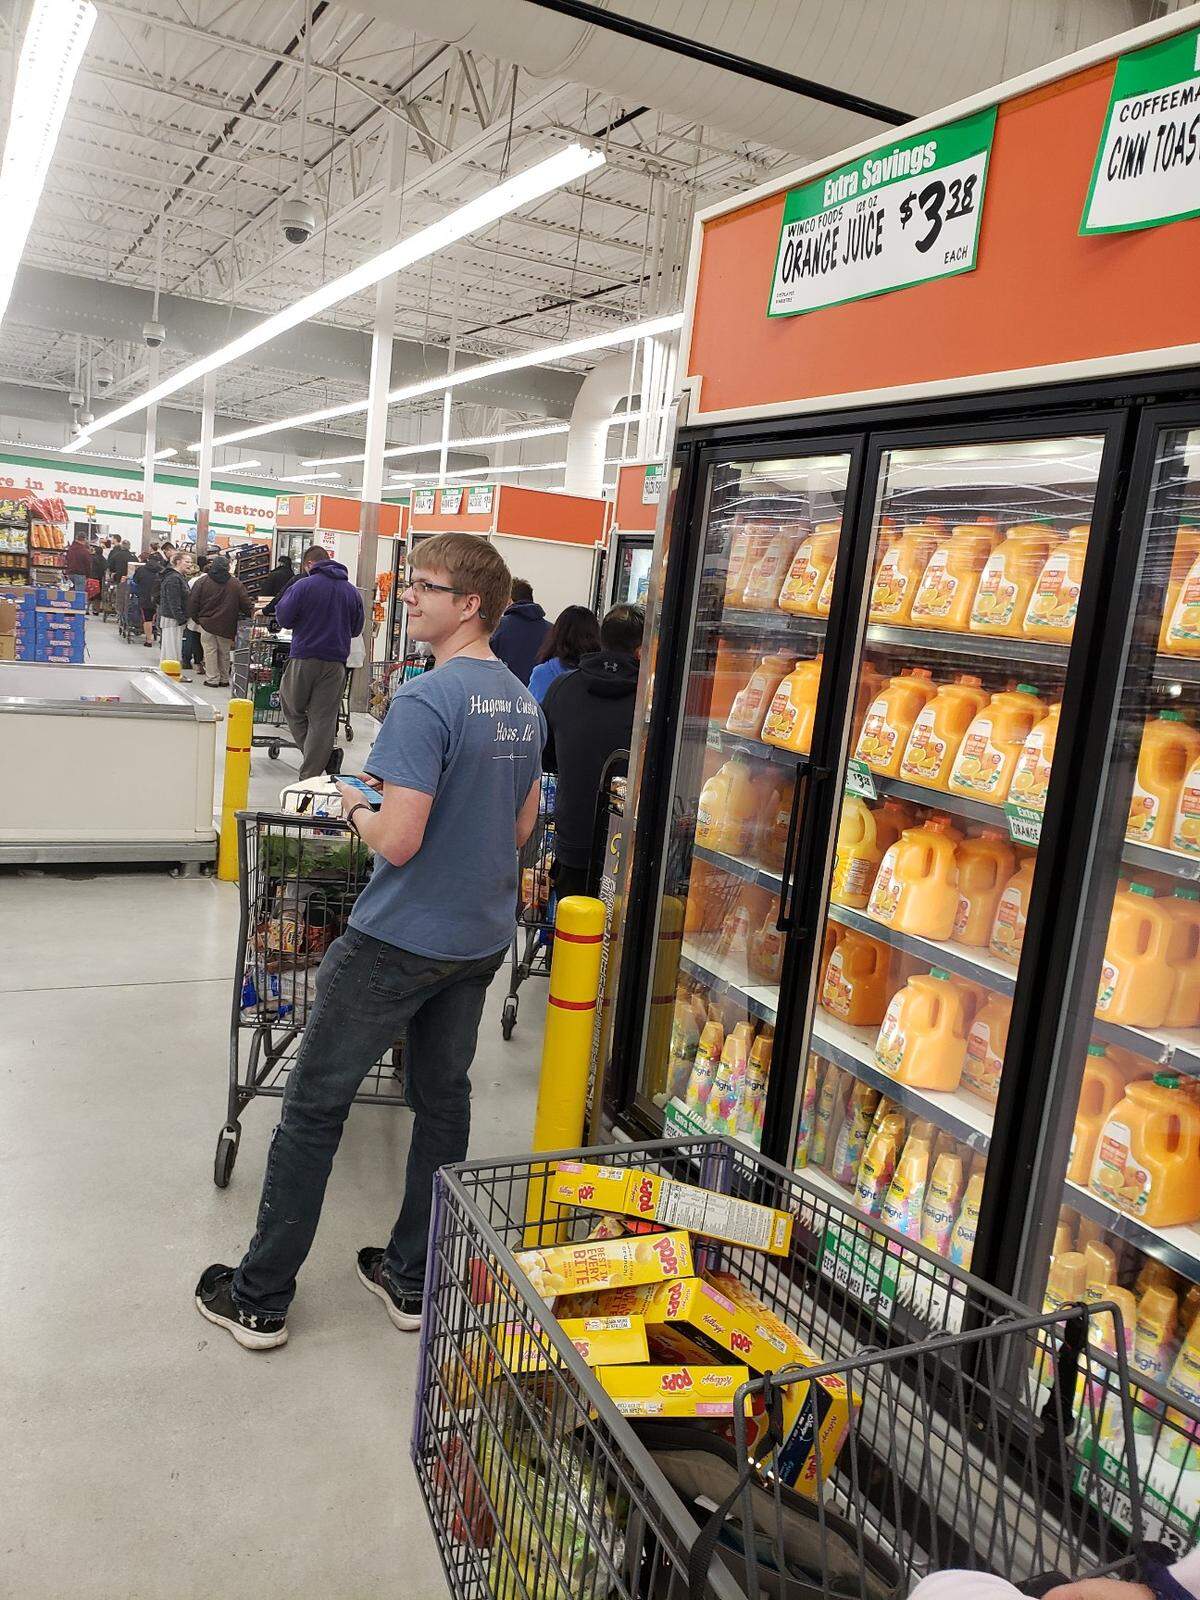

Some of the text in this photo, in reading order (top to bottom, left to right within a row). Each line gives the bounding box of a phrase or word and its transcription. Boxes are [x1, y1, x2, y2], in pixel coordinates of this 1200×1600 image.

[1107, 112, 1200, 182] CINN TOAS
[823, 140, 937, 208] Extra Savings
[787, 217, 817, 238] WINCO
[817, 206, 844, 230] FOODS
[868, 194, 878, 208] OZ
[782, 208, 885, 284] ORANGE JUICE
[943, 245, 968, 265] EACH
[25, 477, 44, 491] in
[55, 480, 144, 503] Kennewick
[214, 501, 275, 520] Restroo
[1012, 822, 1040, 840] ORANGE
[573, 1249, 590, 1285] BITE
[586, 1248, 601, 1282] EVERY
[597, 1246, 608, 1282] BEST IN
[660, 1366, 694, 1392] POPS
[700, 1373, 733, 1387] Kellogg's
